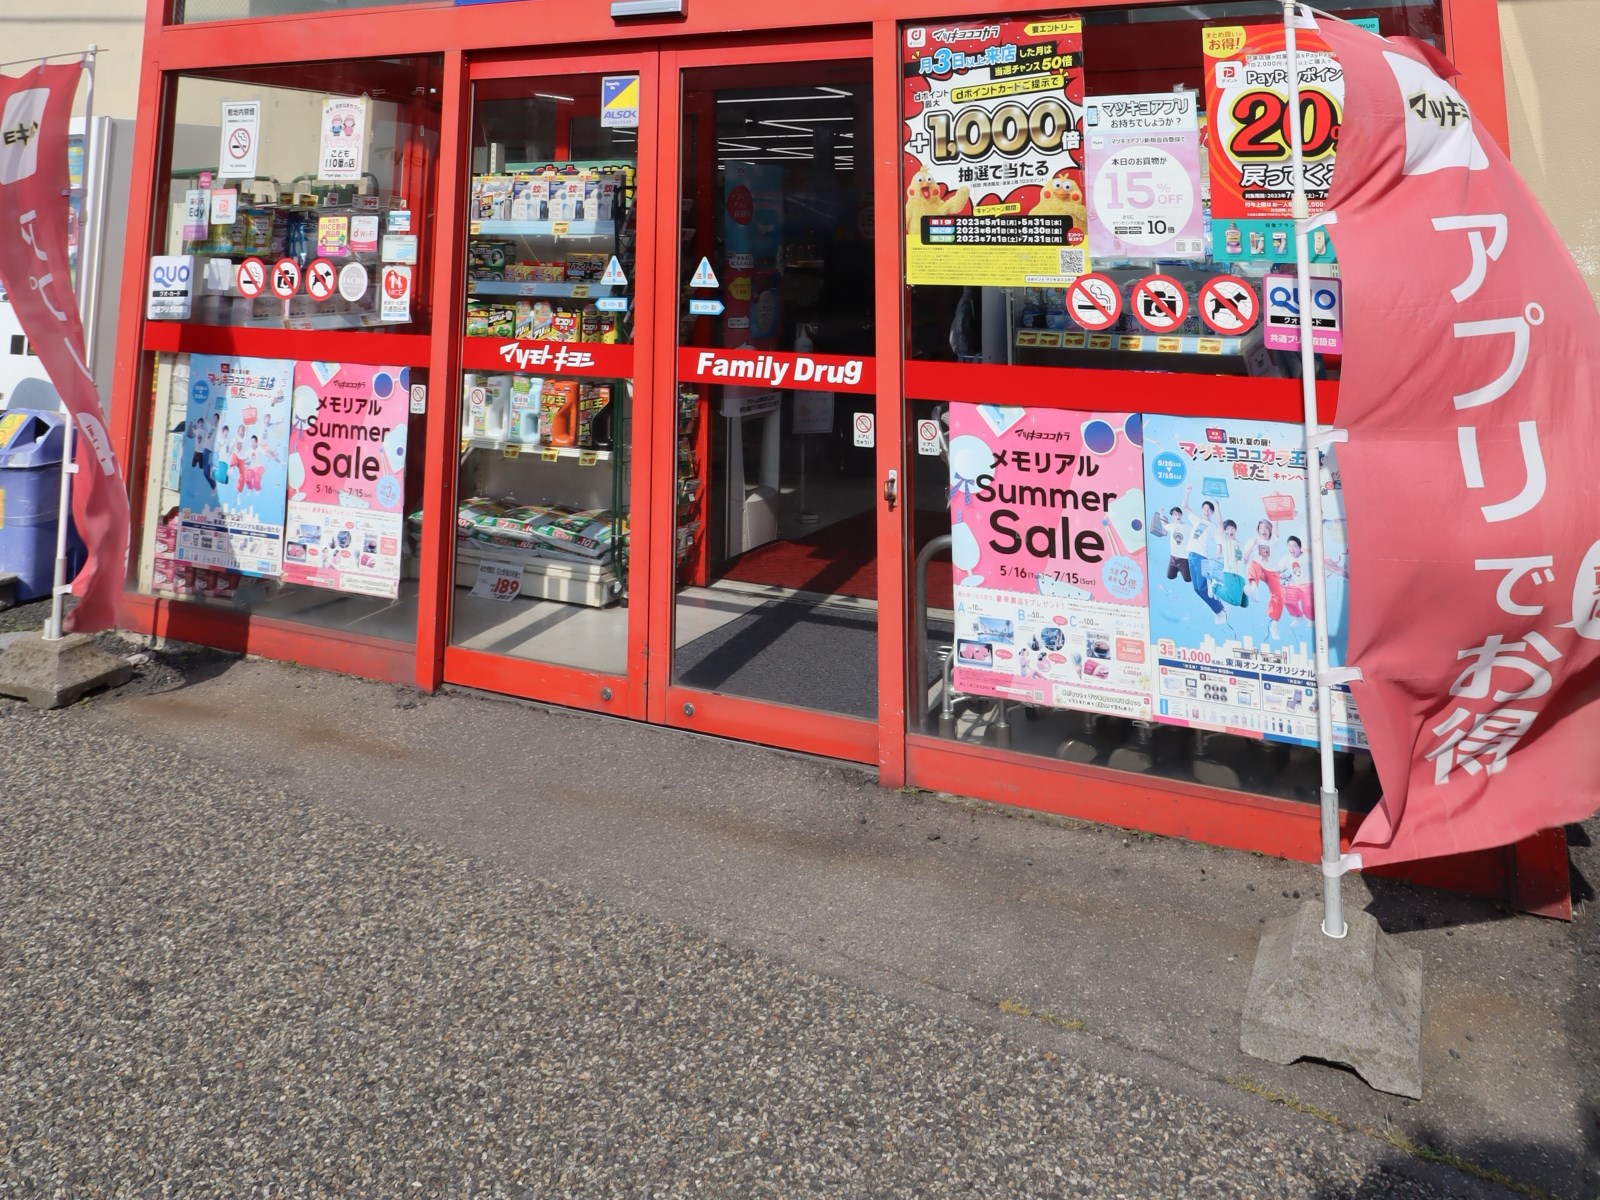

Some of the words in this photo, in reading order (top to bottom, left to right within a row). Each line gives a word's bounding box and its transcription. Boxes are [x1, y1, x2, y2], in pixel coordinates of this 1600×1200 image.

[932, 26, 999, 43] マツキヨココカラ
[228, 108, 255, 116] 敷地内禁煙
[604, 111, 637, 119] ALSOK
[1102, 98, 1189, 117] マツキヨアプリ
[325, 158, 355, 168] 110番の店
[1112, 157, 1167, 166] 本日のお買物が
[958, 161, 1049, 183] 抽選で当たる
[1105, 171, 1156, 209] 15
[1158, 194, 1183, 205] OFF
[189, 208, 205, 219] Edy
[976, 204, 1017, 214] キャンペーン期間
[153, 266, 190, 288] QUO
[500, 342, 594, 371] マツモトキヨシ
[697, 352, 789, 385] Family
[794, 358, 862, 385] Drug
[316, 396, 382, 415] メモリアル
[305, 415, 391, 442] Summer
[1014, 429, 1071, 442] マツキヨココカラ
[311, 441, 380, 481] Sale
[990, 449, 1099, 477] メモリアル
[975, 474, 1118, 512] Summer
[1425, 214, 1563, 785] アプリでお得
[989, 509, 1105, 563] Sale
[495, 577, 519, 594] 189
